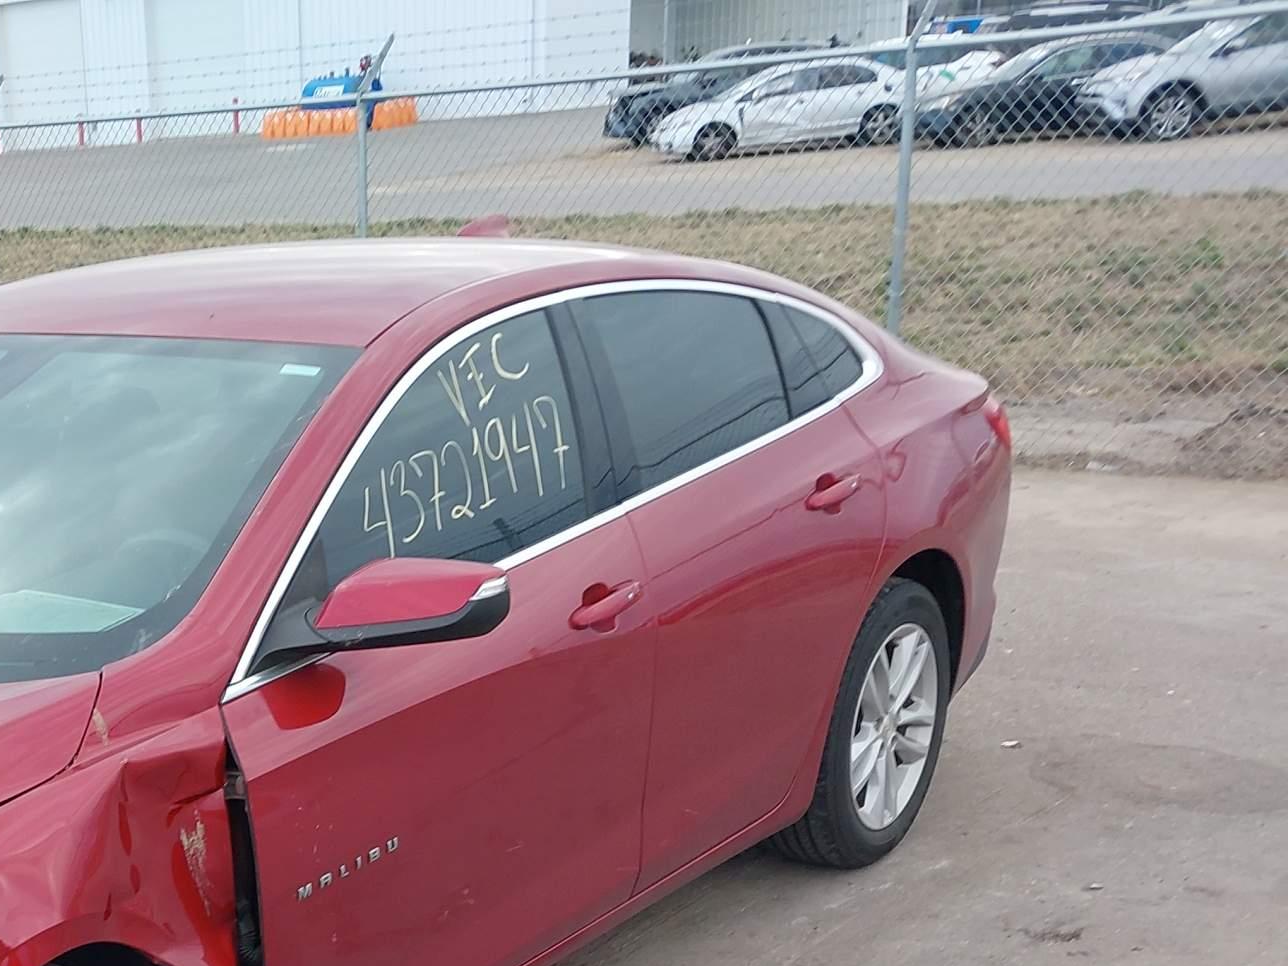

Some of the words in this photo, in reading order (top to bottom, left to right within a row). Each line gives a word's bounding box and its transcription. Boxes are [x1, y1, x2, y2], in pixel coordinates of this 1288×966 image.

[437, 332, 530, 428] VIC
[363, 395, 570, 559] 43721947
[296, 836, 399, 902] MALIBU
